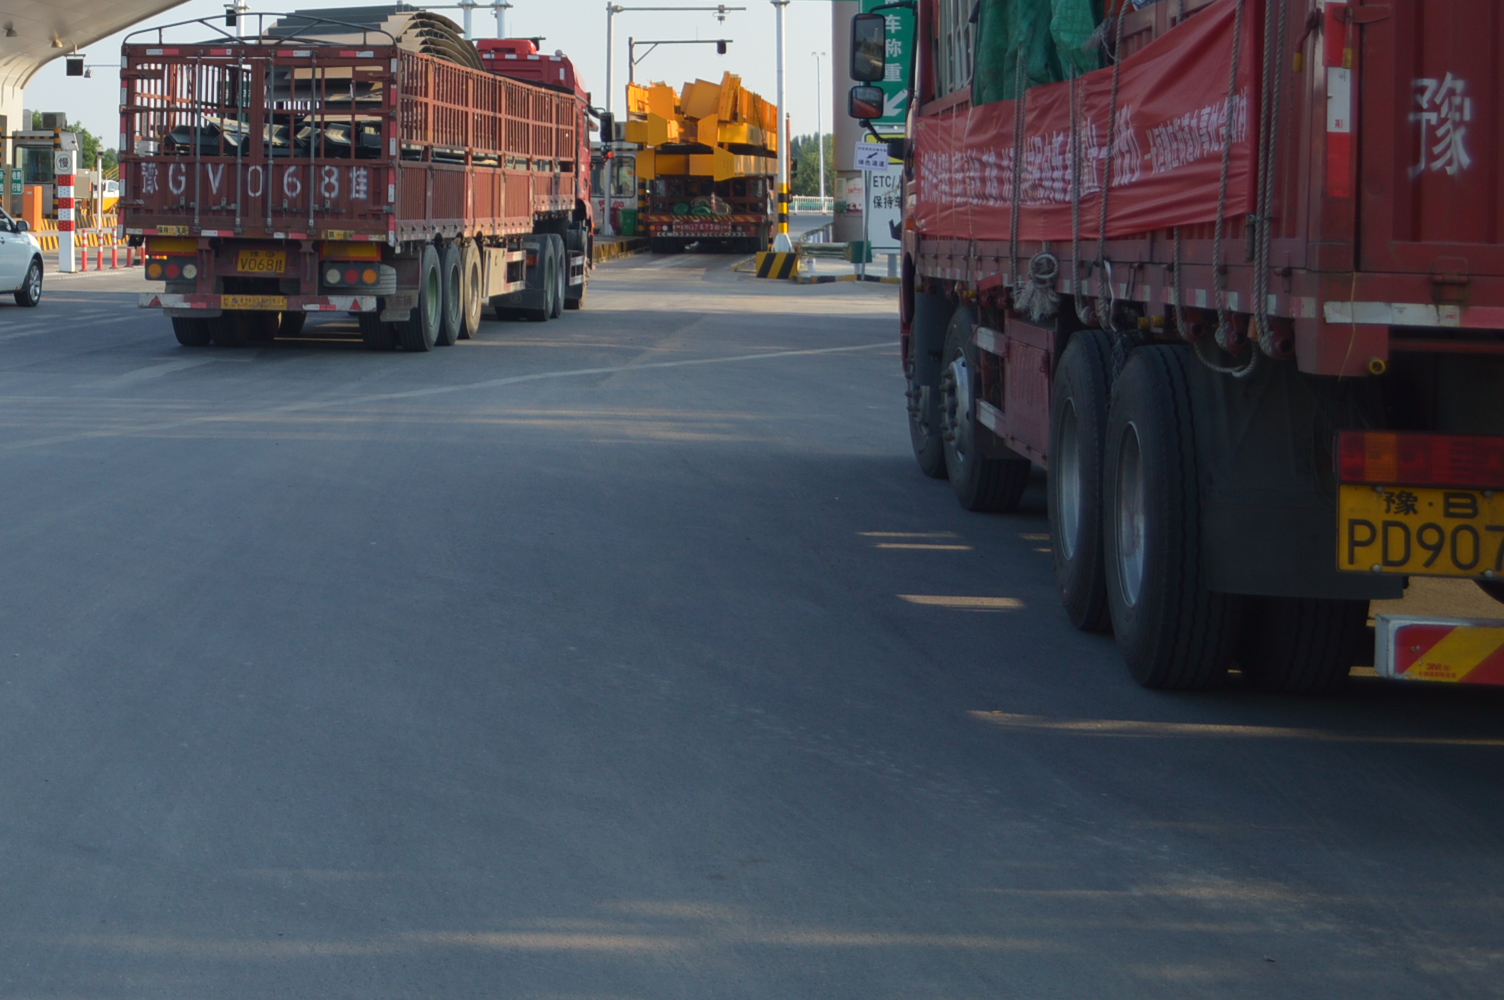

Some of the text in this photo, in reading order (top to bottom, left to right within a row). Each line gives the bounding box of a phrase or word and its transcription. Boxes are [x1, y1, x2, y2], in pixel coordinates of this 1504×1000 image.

[1407, 71, 1472, 179] 豫
[58, 154, 70, 168] 慢
[1348, 518, 1504, 572] PD907
